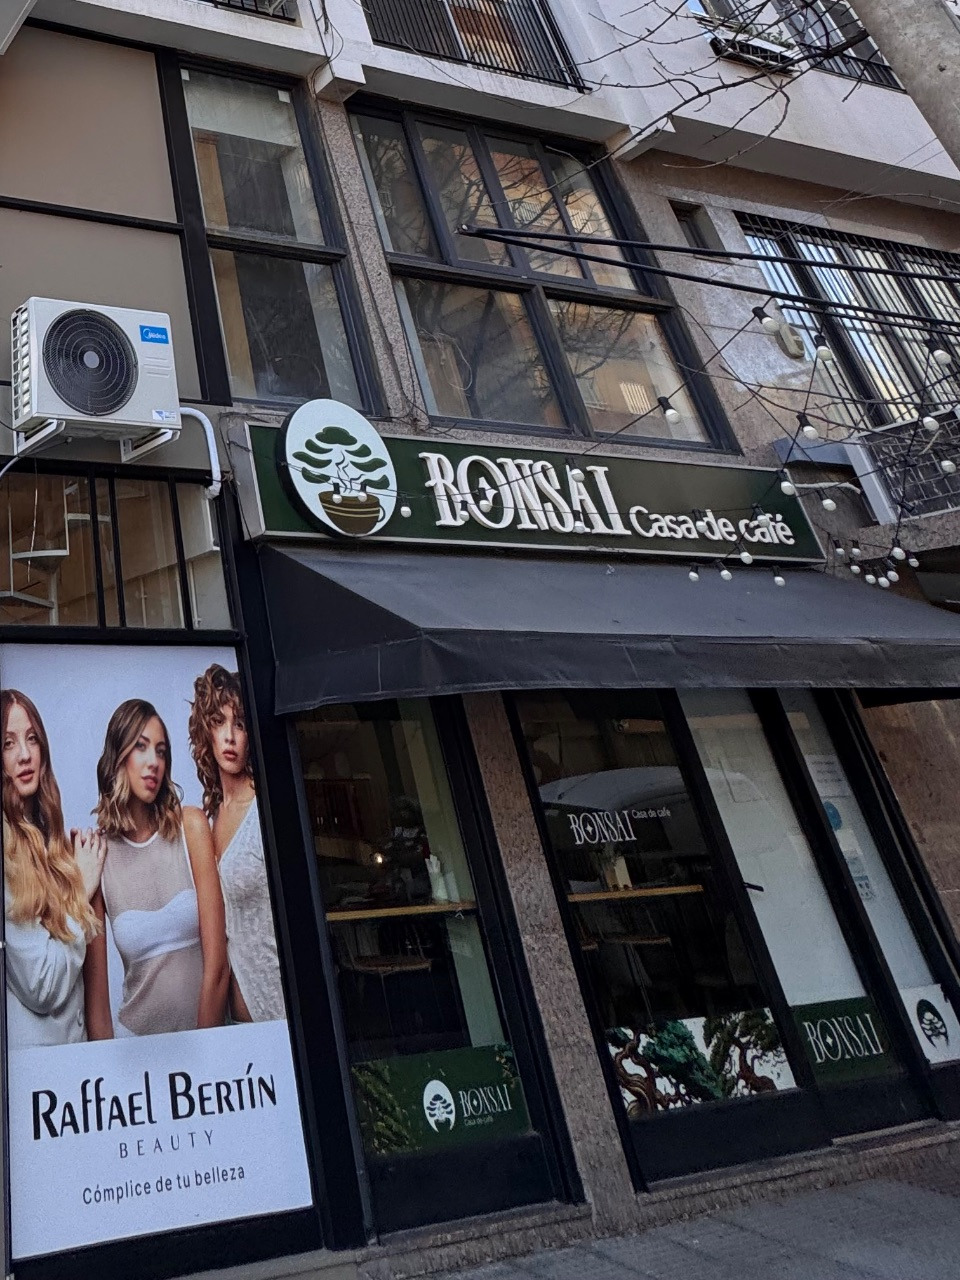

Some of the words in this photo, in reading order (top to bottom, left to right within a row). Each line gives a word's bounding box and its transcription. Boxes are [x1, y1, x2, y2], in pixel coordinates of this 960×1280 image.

[418, 451, 632, 535] BONSAI
[629, 505, 699, 539] Casa
[702, 509, 737, 542] de
[739, 513, 795, 545] café
[567, 809, 637, 845] BONSAI
[802, 1012, 884, 1064] BONSAI
[459, 1083, 513, 1118] BONSAI
[119, 1129, 214, 1159] BEAUTY
[82, 1179, 152, 1205] Cómplice
[155, 1175, 173, 1193] de
[176, 1172, 191, 1190] tu
[195, 1166, 246, 1187] belleza
